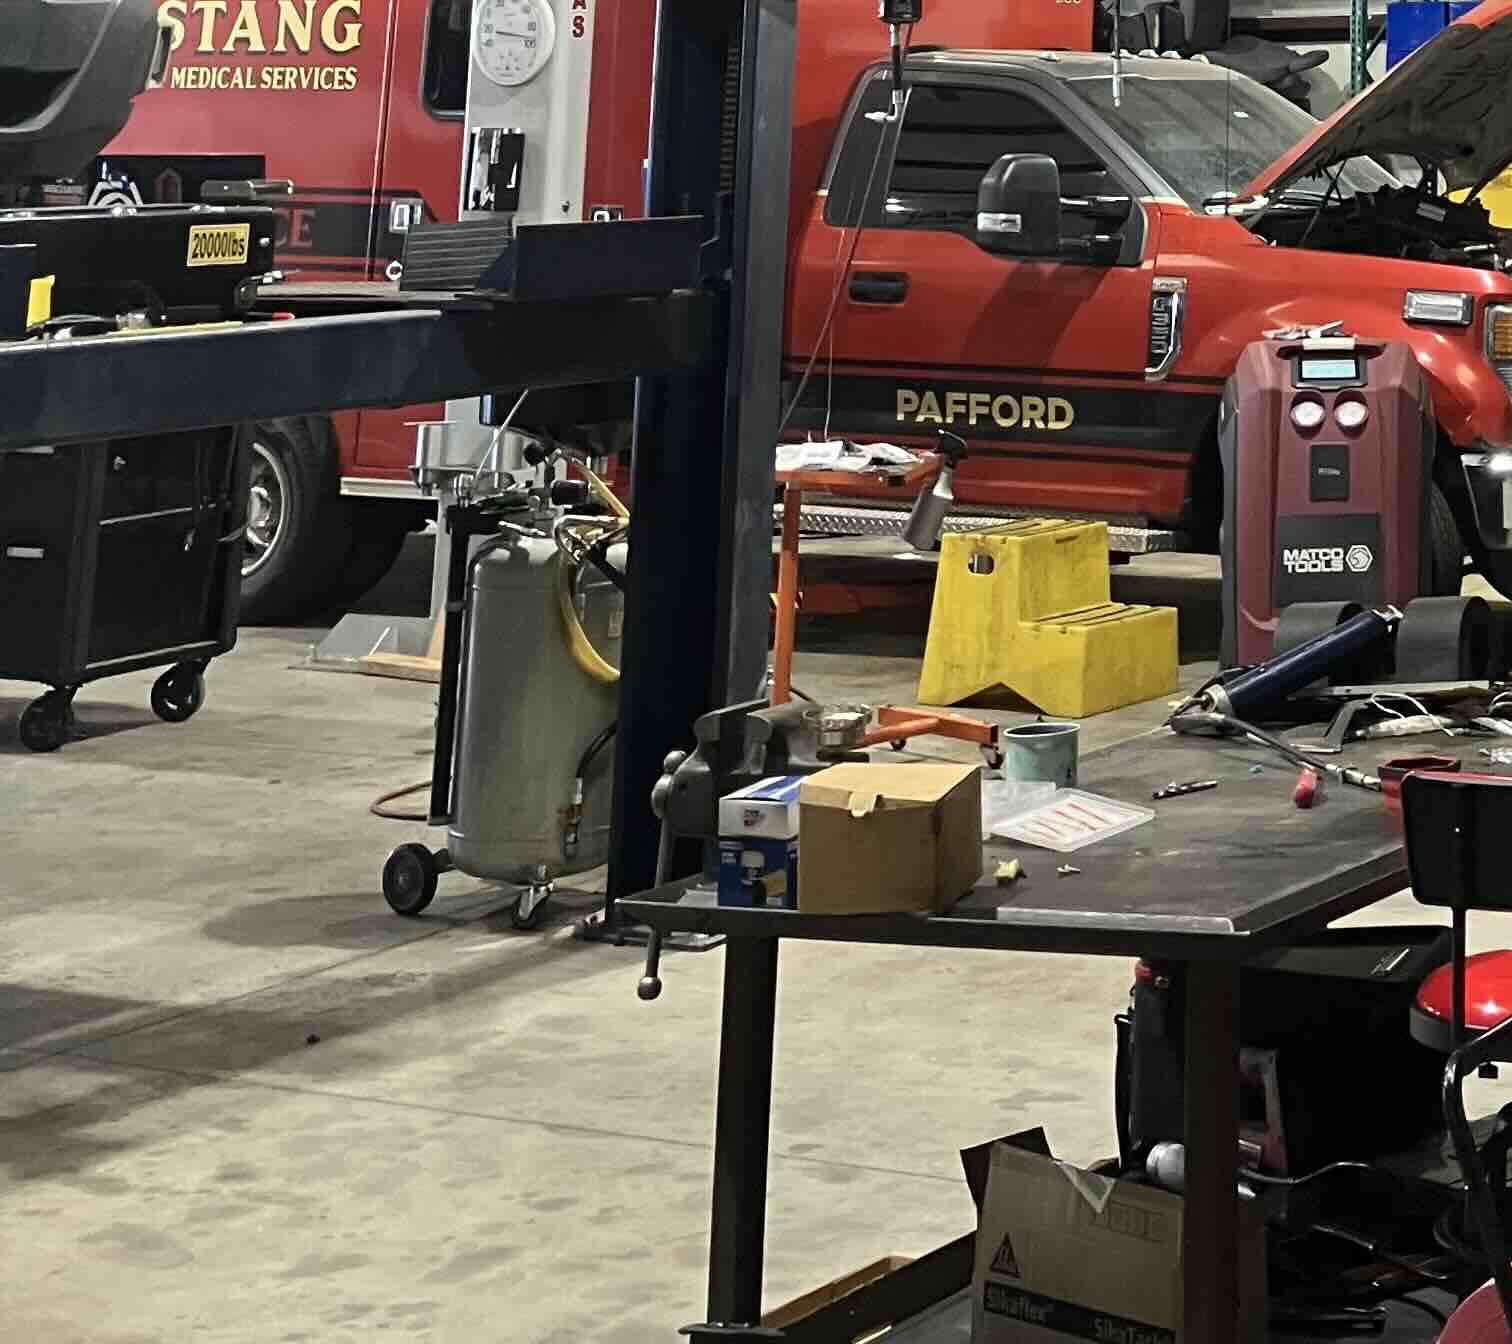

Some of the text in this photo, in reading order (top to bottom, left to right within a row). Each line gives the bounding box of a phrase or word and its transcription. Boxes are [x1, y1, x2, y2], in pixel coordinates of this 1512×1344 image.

[171, 66, 358, 90] MEDICAL SERVICES
[896, 388, 1075, 431] PAFFORD
[1282, 547, 1344, 561] MATCO
[1282, 561, 1344, 574] TOOLS
